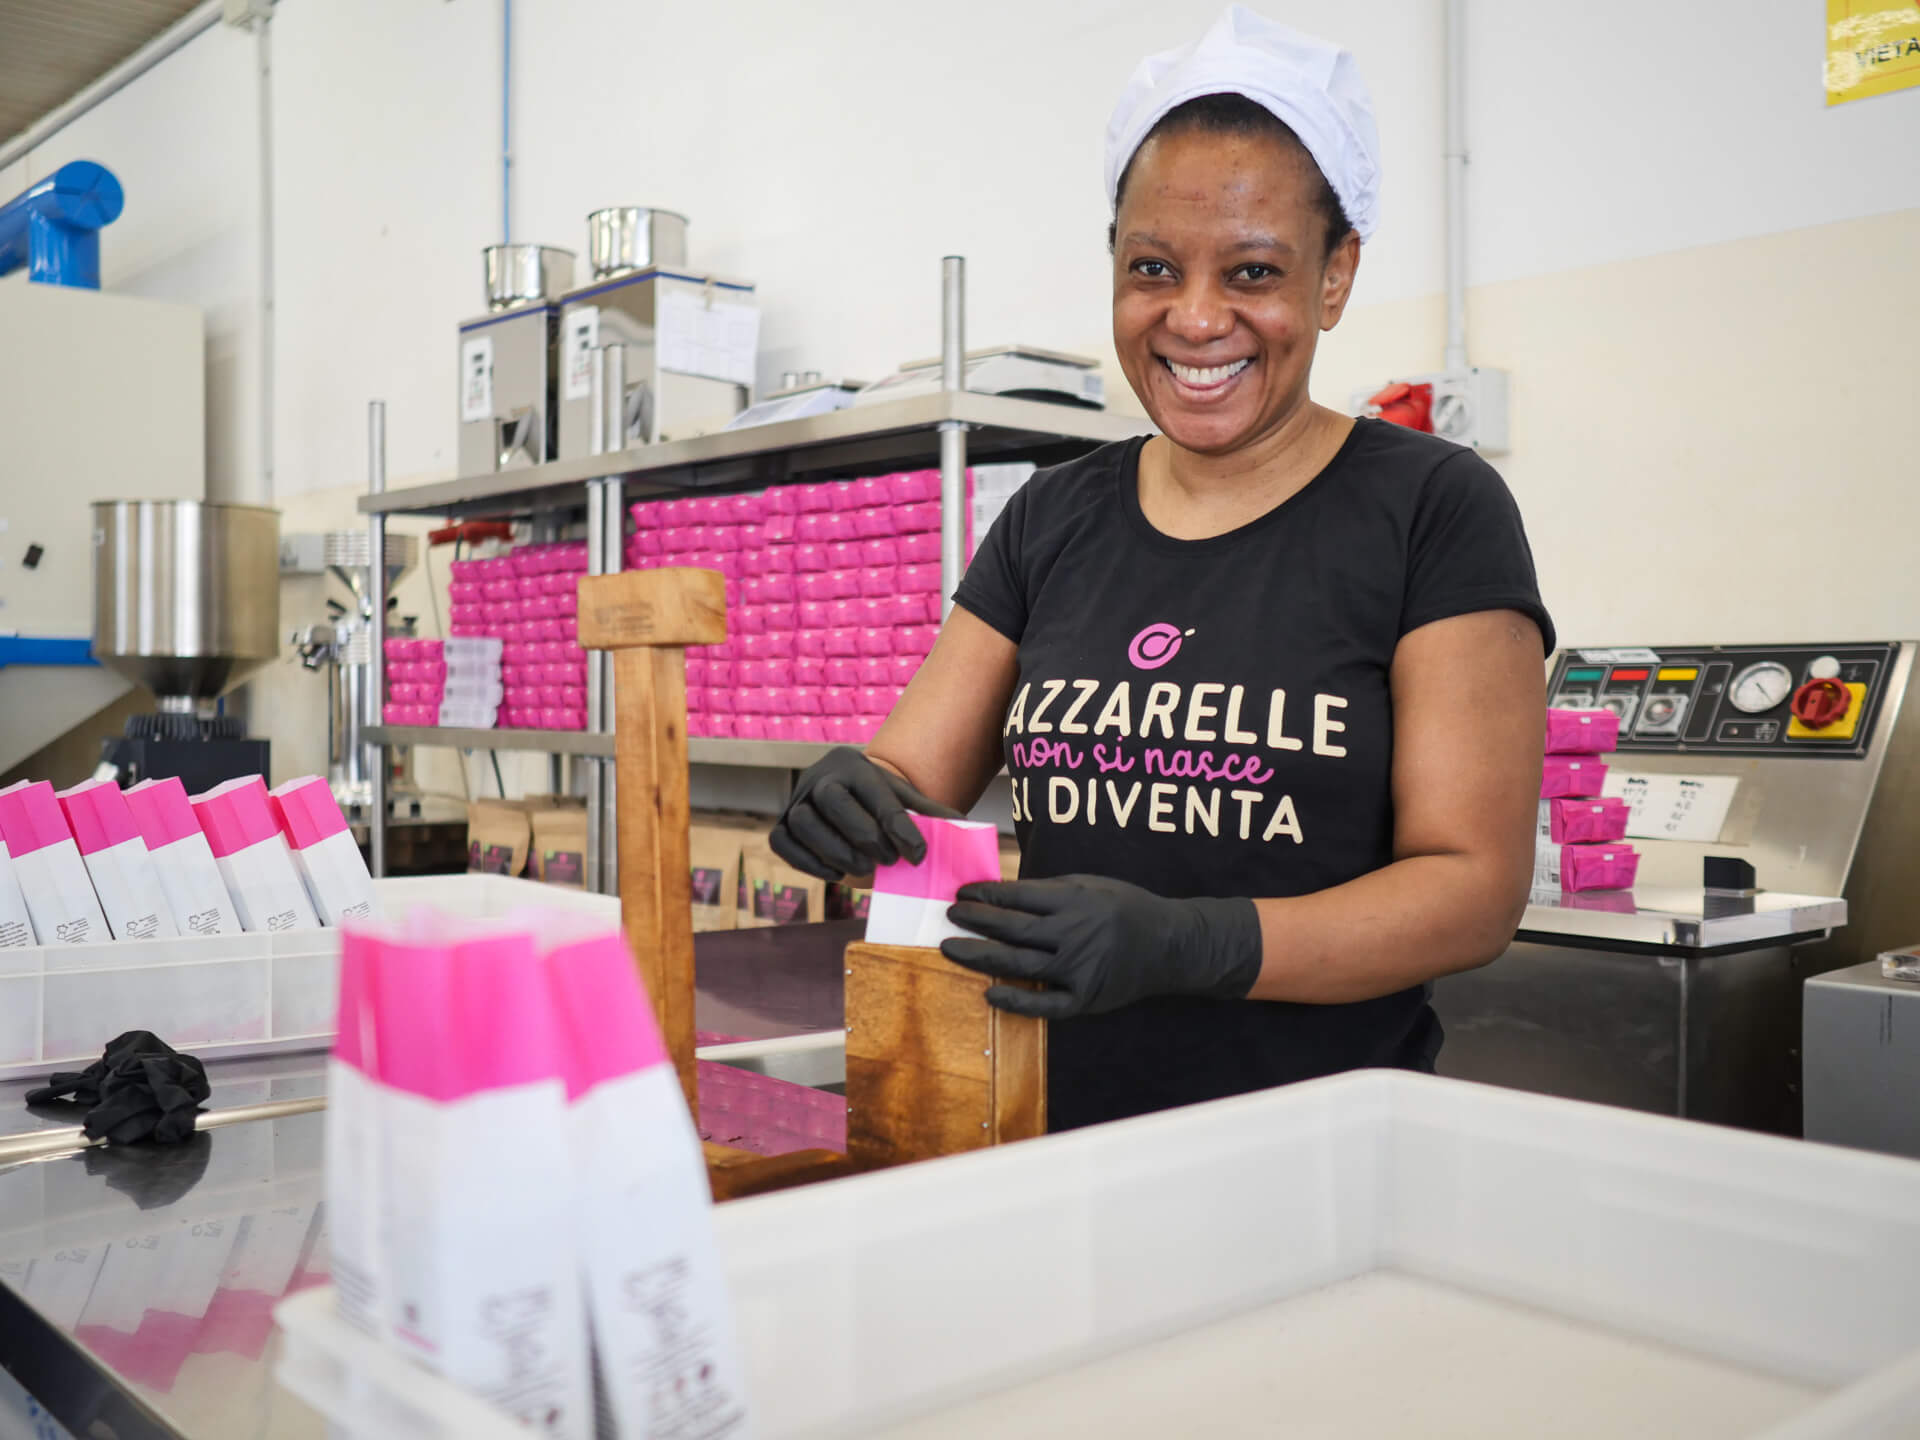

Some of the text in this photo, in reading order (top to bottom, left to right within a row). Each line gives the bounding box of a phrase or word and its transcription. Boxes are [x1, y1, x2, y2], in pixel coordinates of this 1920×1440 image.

[1003, 679, 1349, 758] AZZARELLE
[1012, 736, 1275, 784] non si nasce
[1011, 776, 1304, 845] SI DIVENTA
